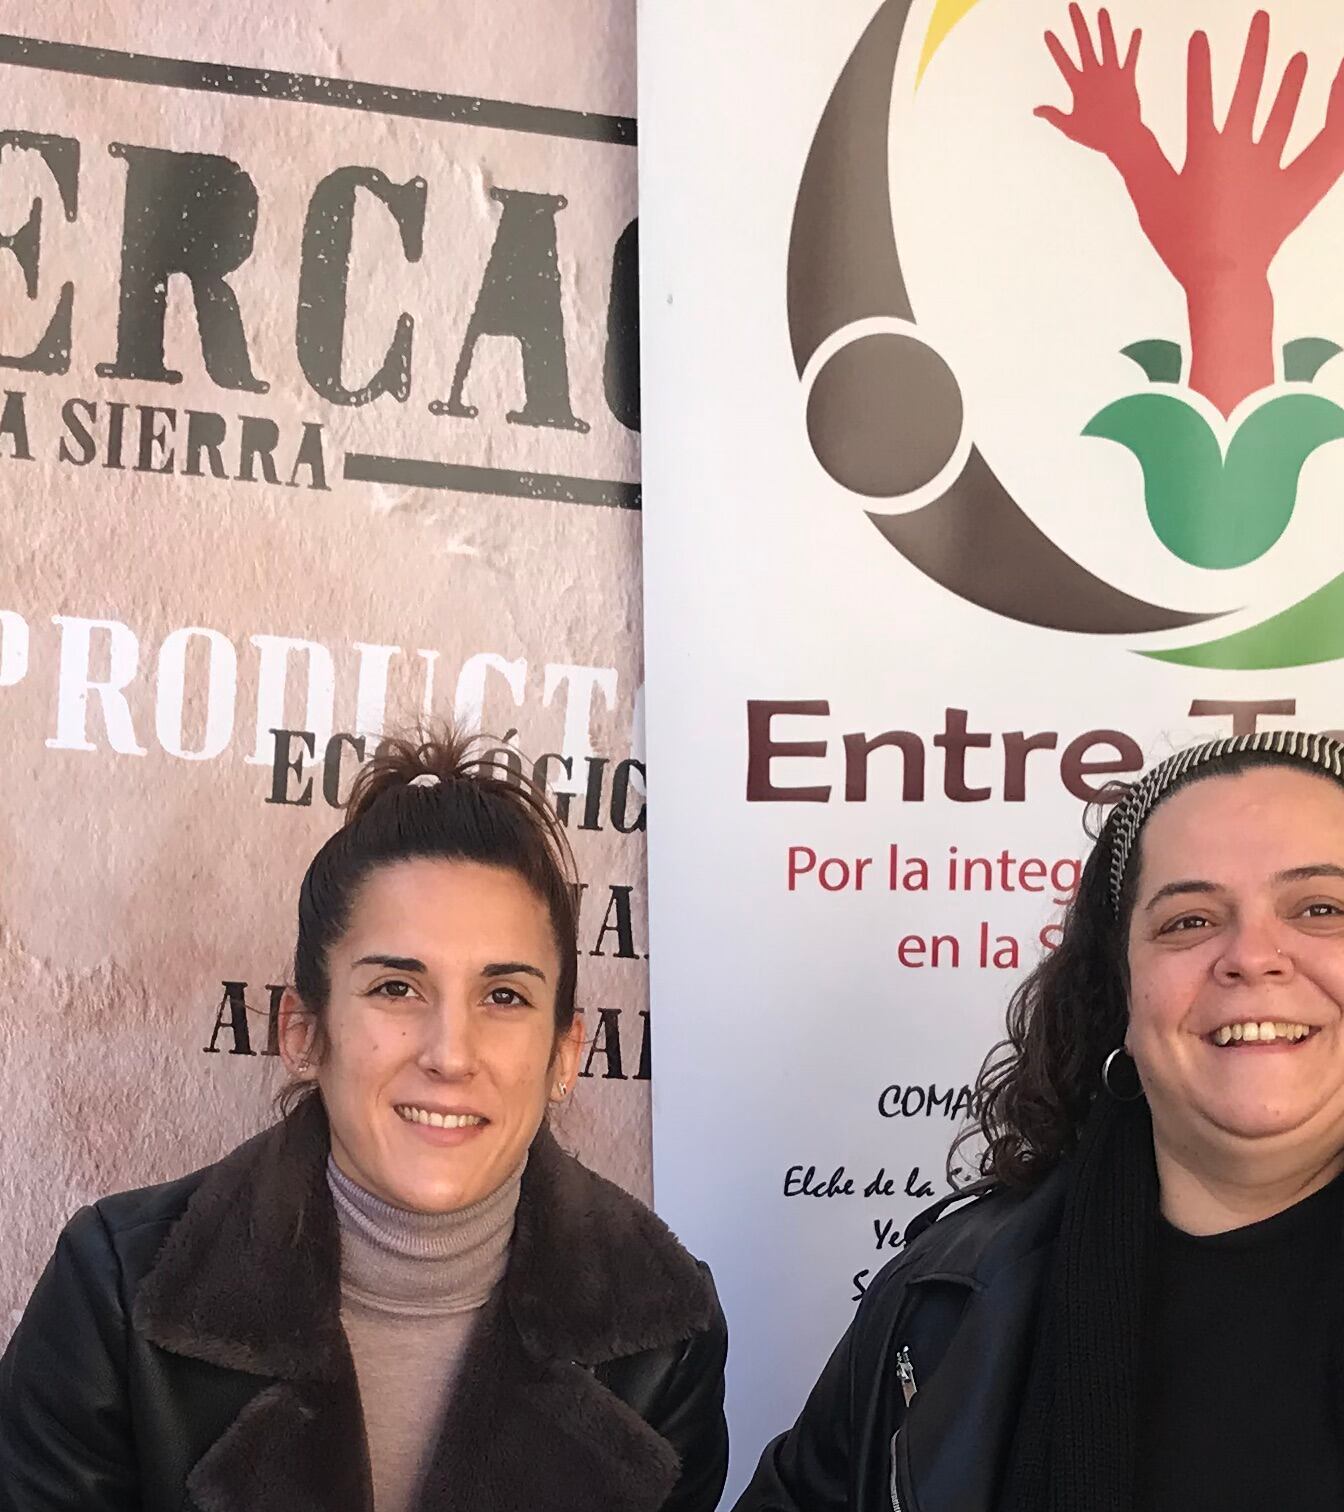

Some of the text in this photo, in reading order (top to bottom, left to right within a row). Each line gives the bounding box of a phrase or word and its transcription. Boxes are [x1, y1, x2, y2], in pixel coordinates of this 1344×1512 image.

[58, 397, 334, 491] SIERRA
[746, 699, 1144, 803] Entre
[787, 846, 873, 892] Por
[889, 844, 929, 892] la
[897, 933, 960, 968] en
[979, 921, 1019, 969] la
[782, 1165, 856, 1198] Elche
[863, 1167, 896, 1198] de
[903, 1166, 936, 1198] la
